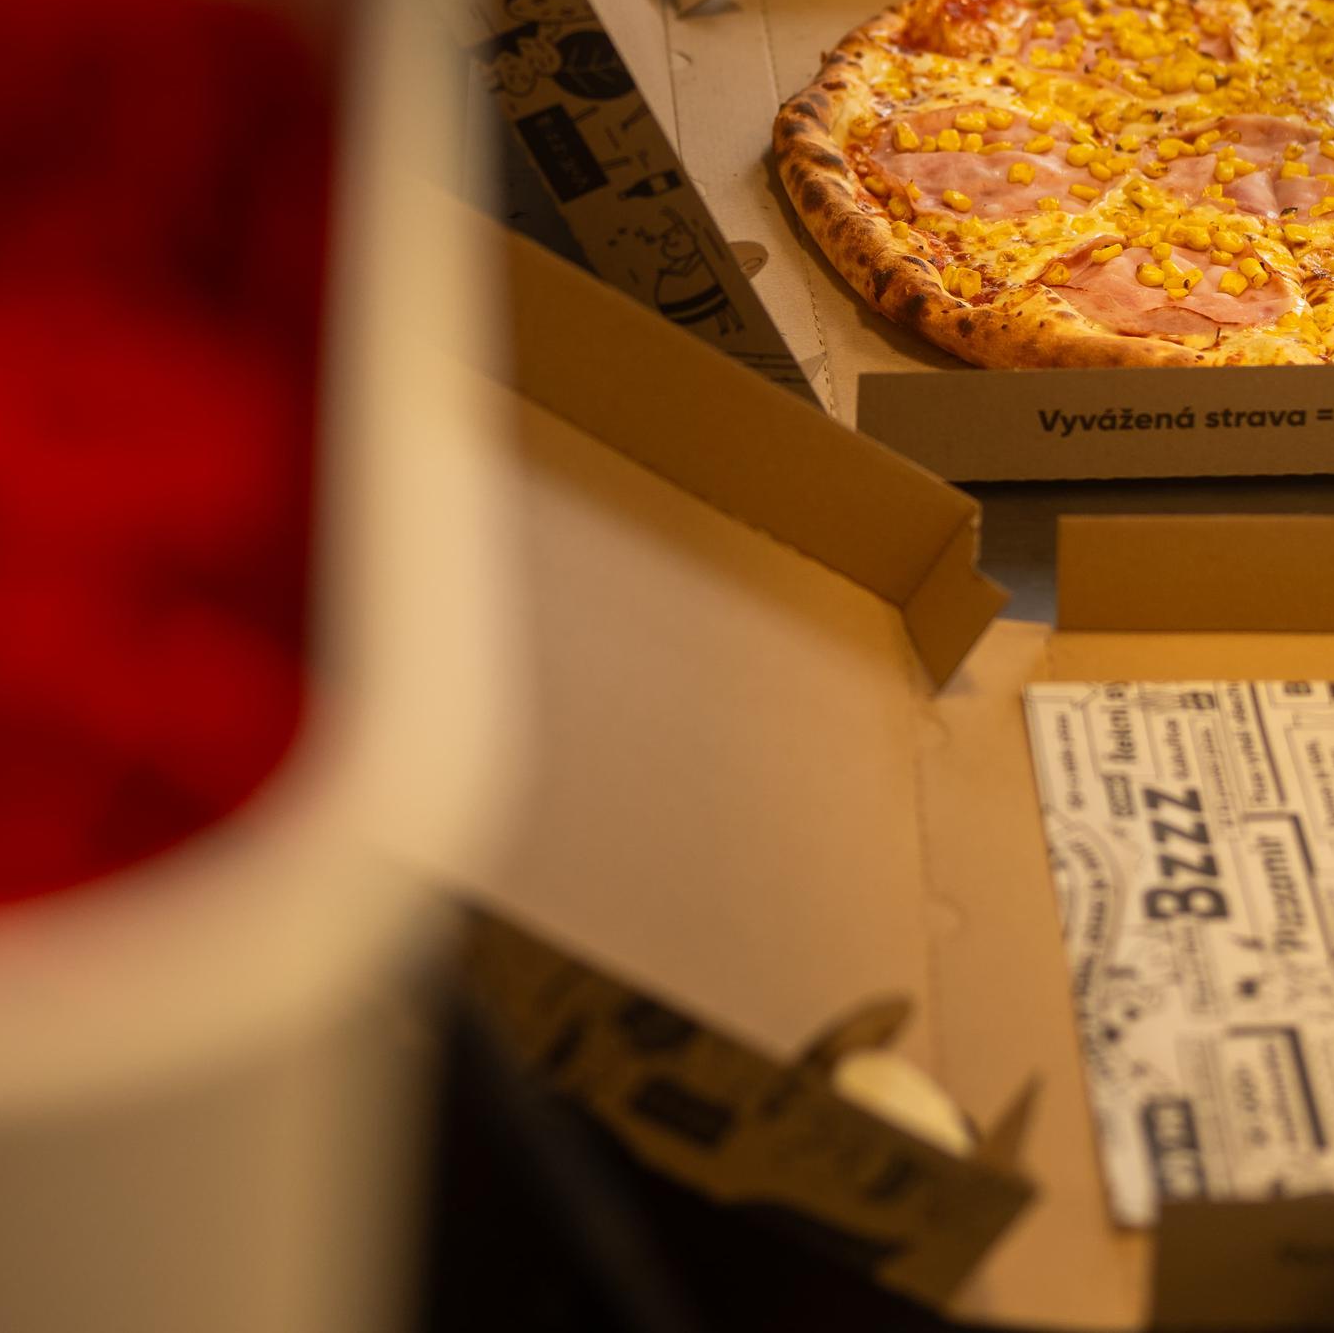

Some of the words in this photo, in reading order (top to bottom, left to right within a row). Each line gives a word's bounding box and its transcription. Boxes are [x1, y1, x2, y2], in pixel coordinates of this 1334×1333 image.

[1038, 406, 1196, 437] Vyvážená
[1204, 405, 1307, 429] strava
[1316, 408, 1334, 421] =
[1141, 787, 1230, 921] Bzzz
